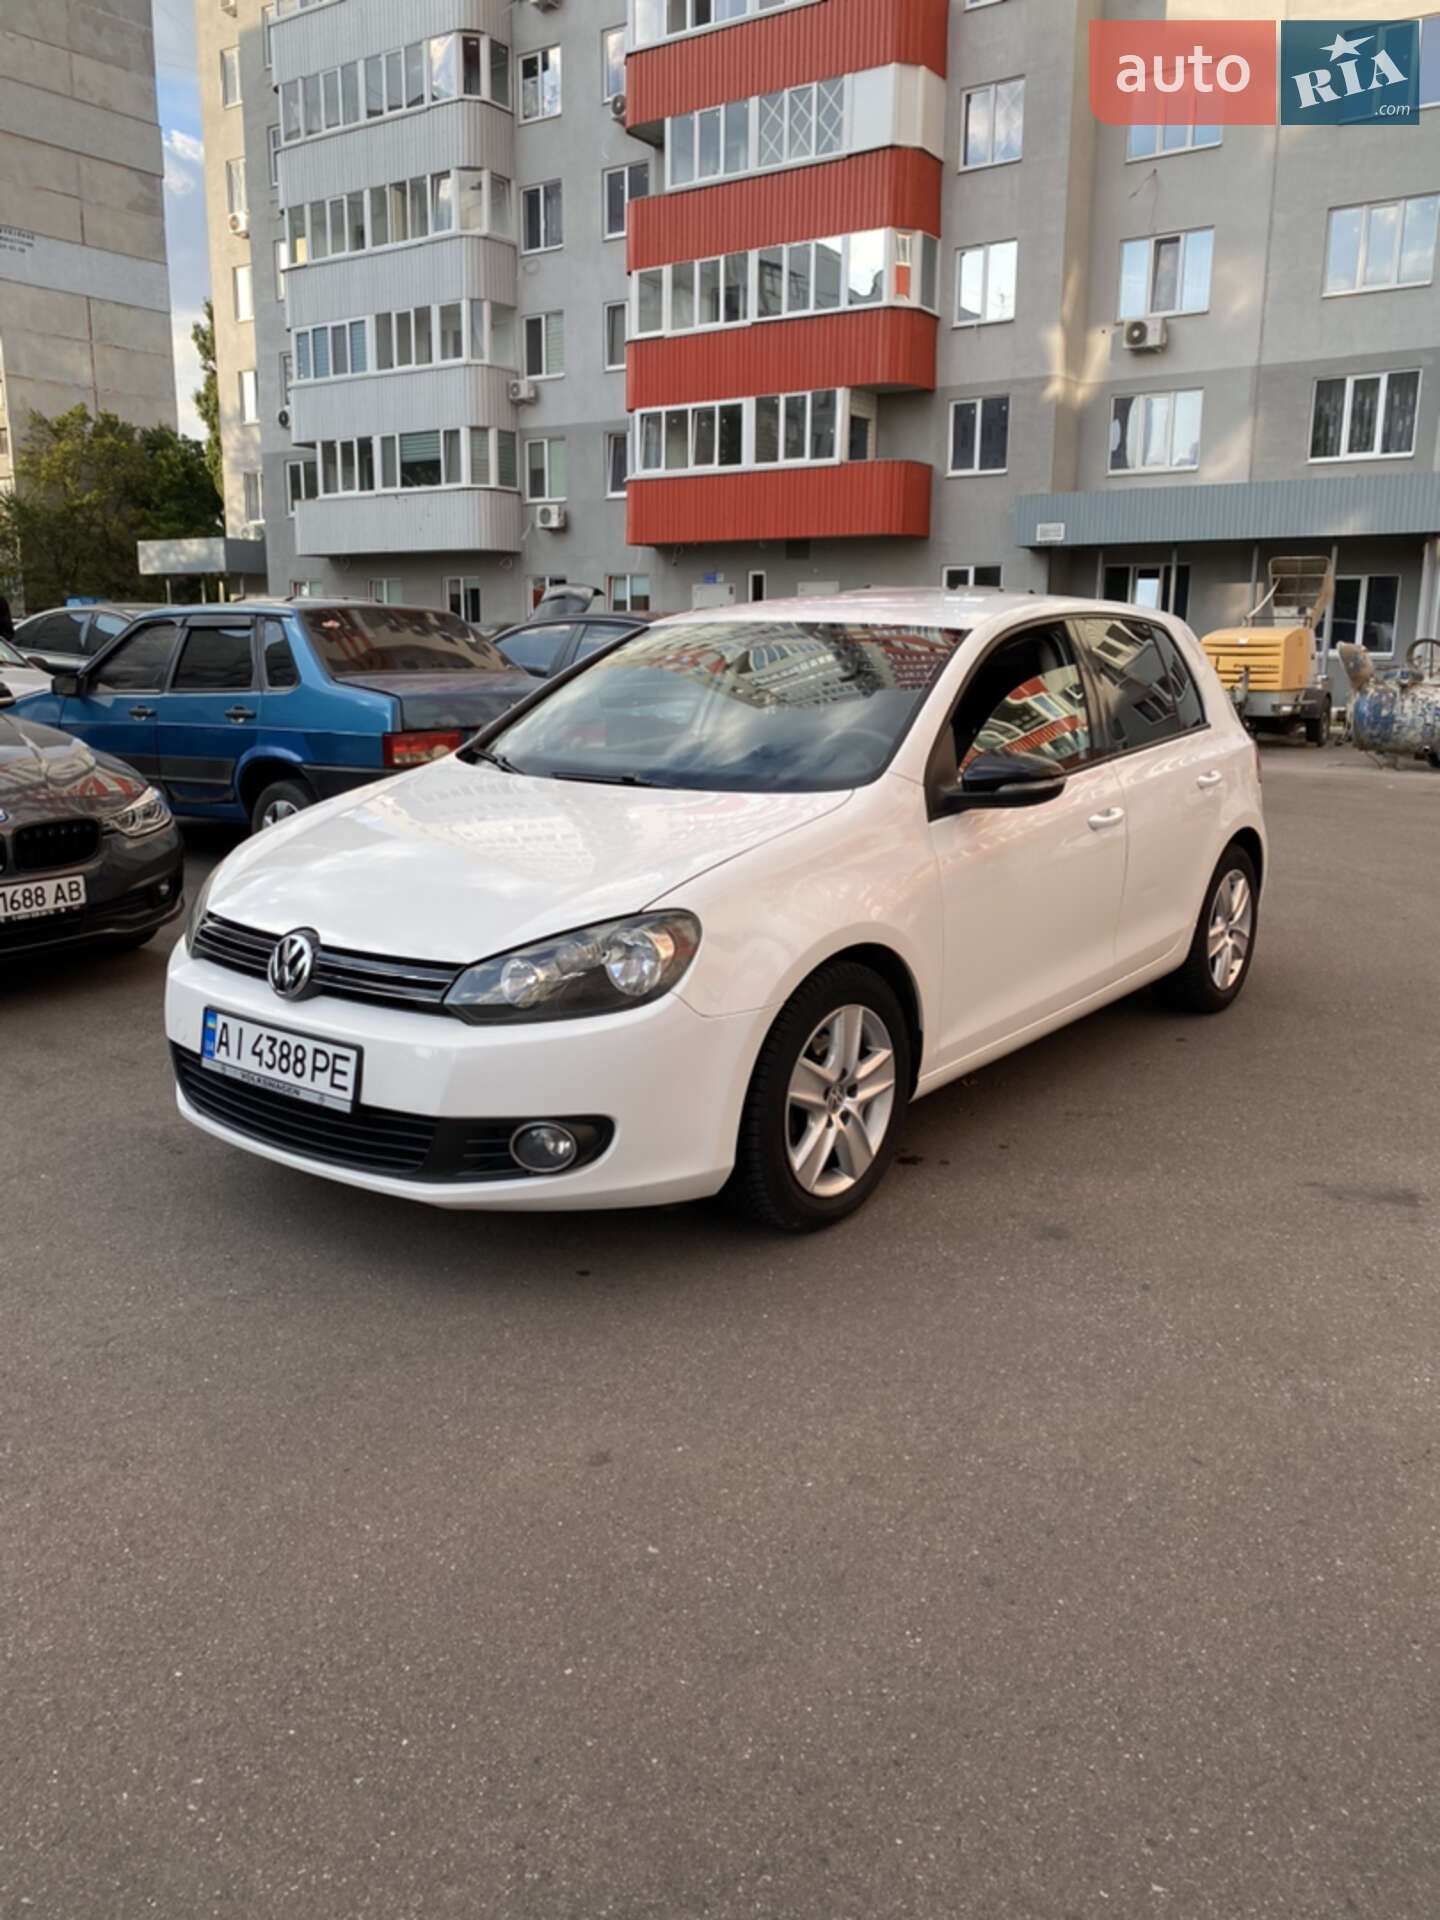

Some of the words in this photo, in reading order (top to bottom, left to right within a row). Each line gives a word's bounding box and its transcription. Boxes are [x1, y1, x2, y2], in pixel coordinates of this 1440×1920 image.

[0, 885, 46, 913] 1688
[54, 880, 82, 904] AB
[216, 1022, 243, 1060] AI
[251, 1033, 306, 1079] 4388
[310, 1047, 351, 1092] PE
